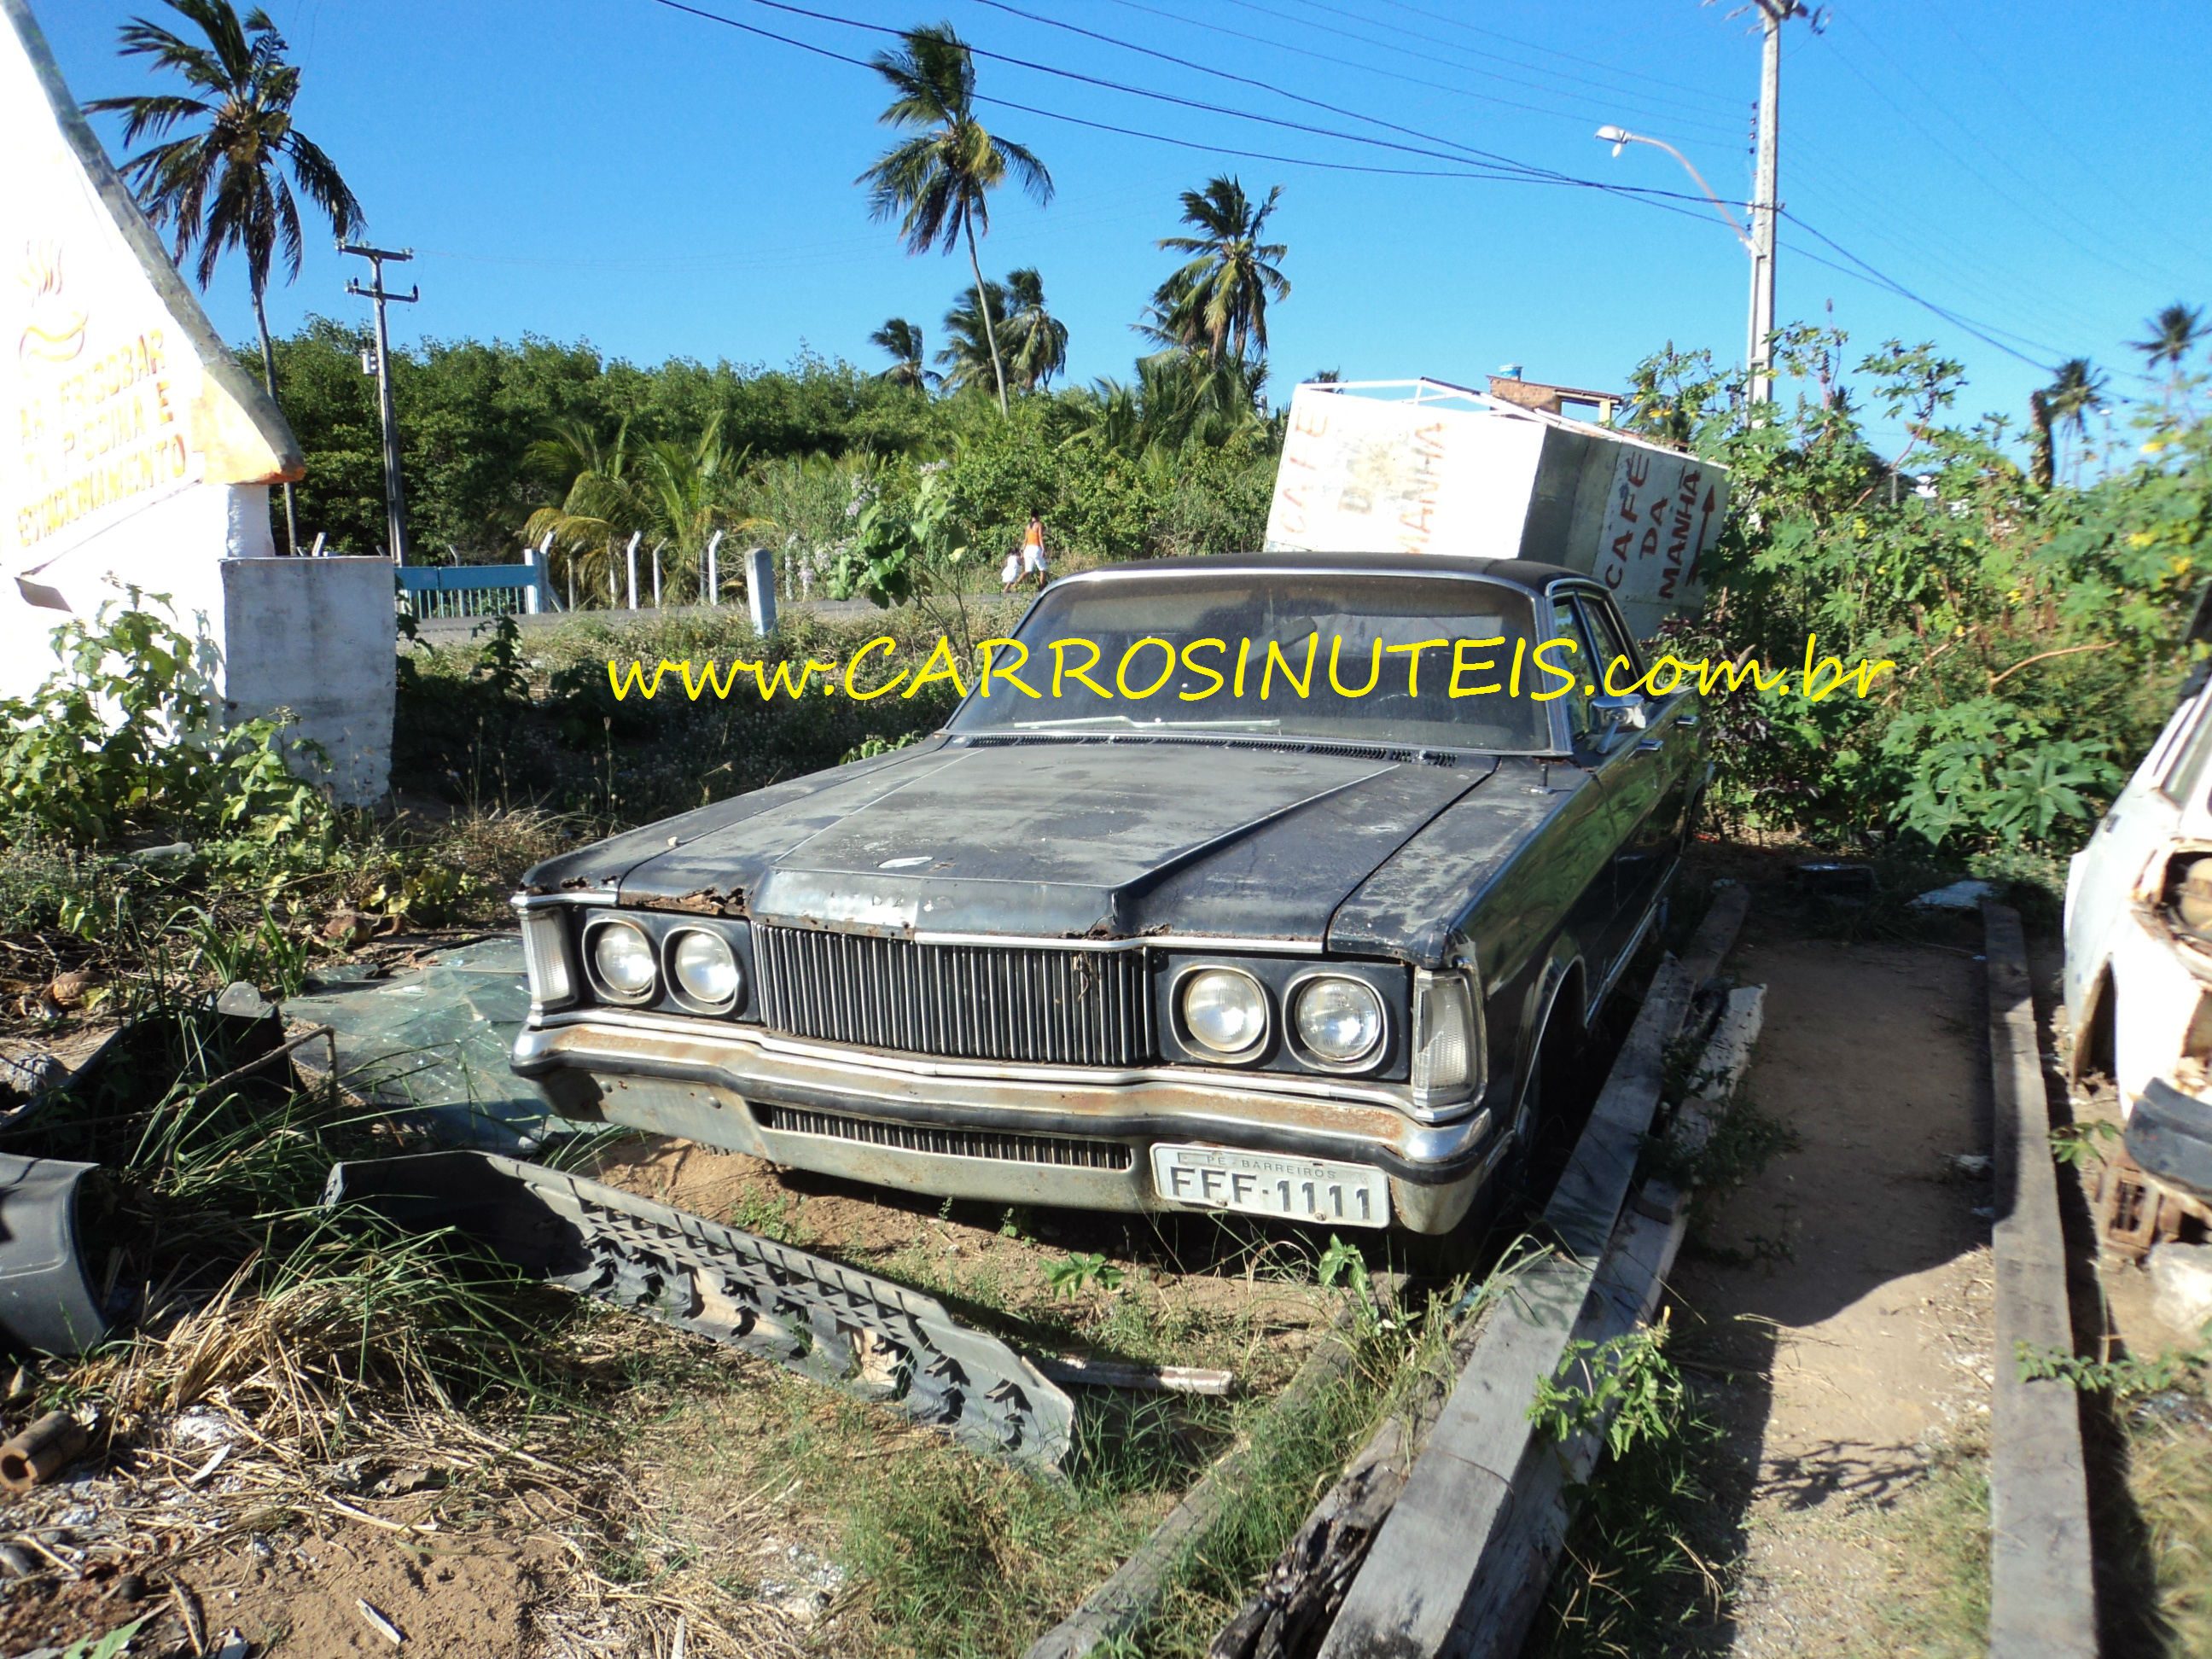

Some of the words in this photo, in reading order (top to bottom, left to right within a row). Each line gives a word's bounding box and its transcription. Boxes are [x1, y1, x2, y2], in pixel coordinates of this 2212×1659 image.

[62, 393, 147, 471] PSCINA
[156, 381, 174, 427] E
[1639, 496, 1668, 561] DA
[1657, 464, 1702, 600] MANHÃ
[1170, 1166, 1371, 1220] FFF-1111
[1242, 1159, 1337, 1180] BARREIROS
